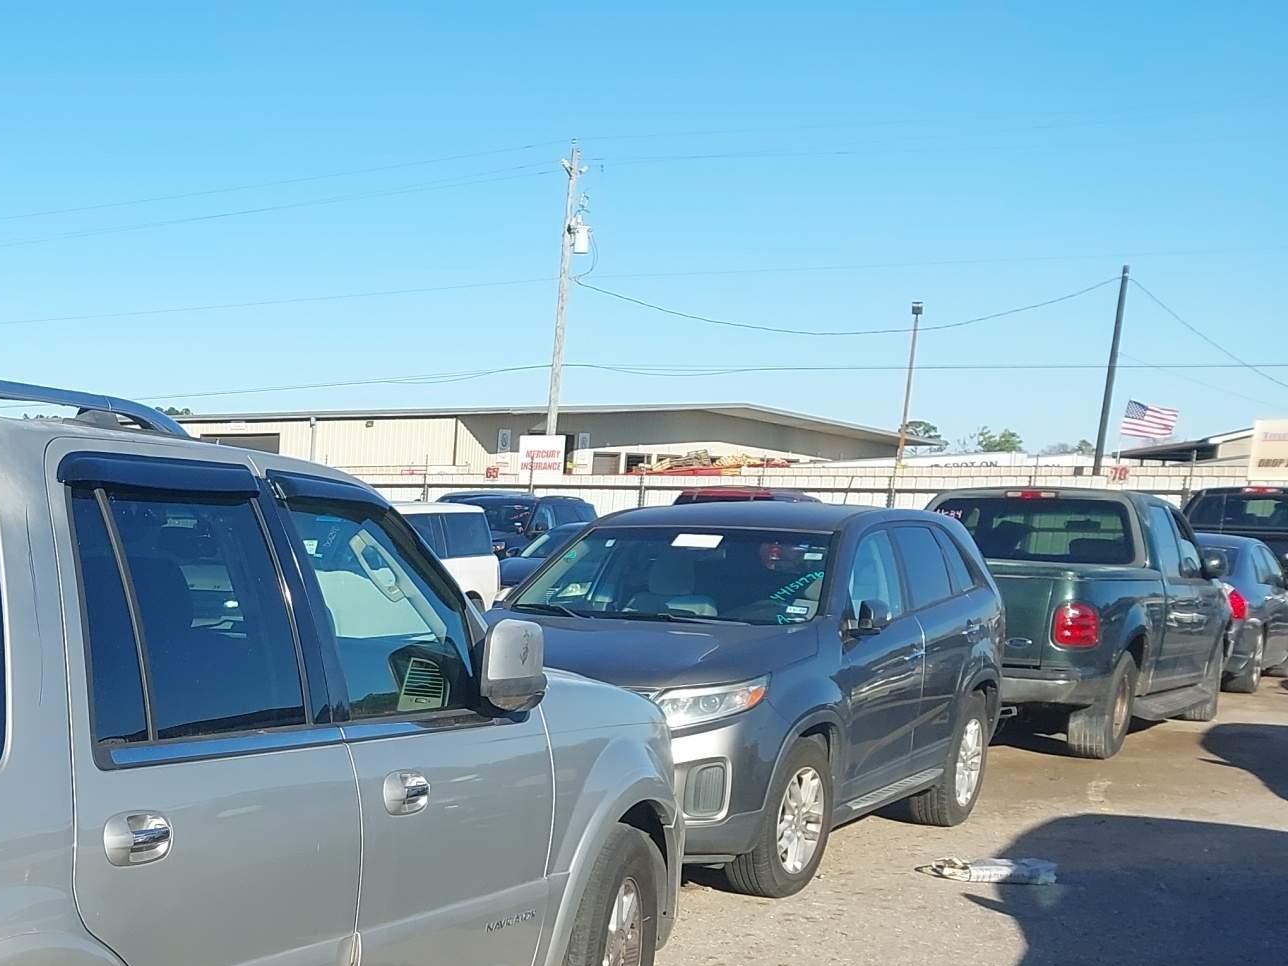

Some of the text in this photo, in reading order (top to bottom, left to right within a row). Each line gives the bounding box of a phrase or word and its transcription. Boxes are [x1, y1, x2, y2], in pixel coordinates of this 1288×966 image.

[525, 449, 561, 458] MERCURY
[520, 462, 561, 471] INSURANCE
[486, 467, 499, 478] 65
